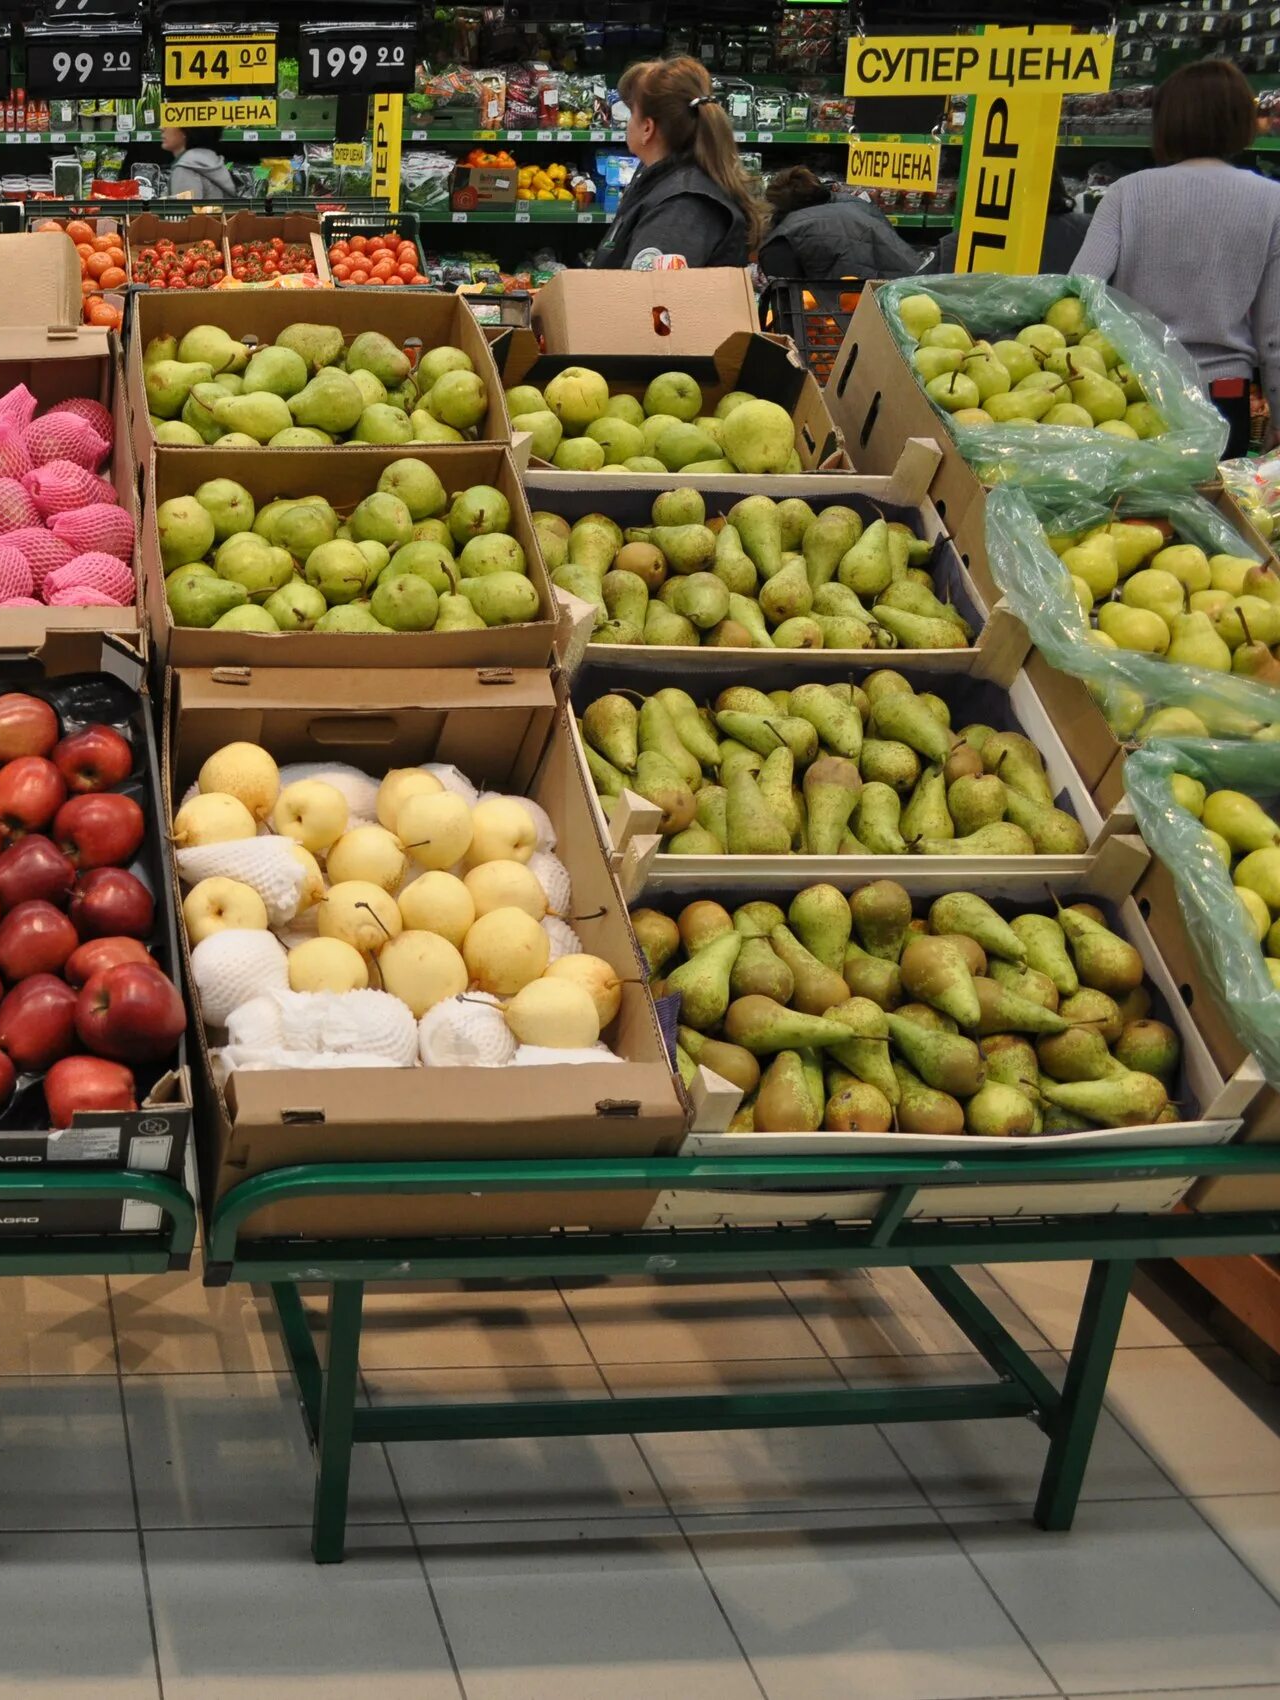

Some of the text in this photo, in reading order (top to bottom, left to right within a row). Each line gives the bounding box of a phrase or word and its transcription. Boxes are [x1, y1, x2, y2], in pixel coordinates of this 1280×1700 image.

[53, 51, 131, 83] 99 90
[171, 47, 267, 80] 144 00
[309, 45, 404, 78] 199 90
[856, 47, 1100, 87] СУПЕР ЦЕНА
[164, 106, 271, 123] СУПЕР ЦЕНА
[851, 150, 932, 184] СУПЕР ЦЕНА
[967, 97, 1019, 272] ПЕР
